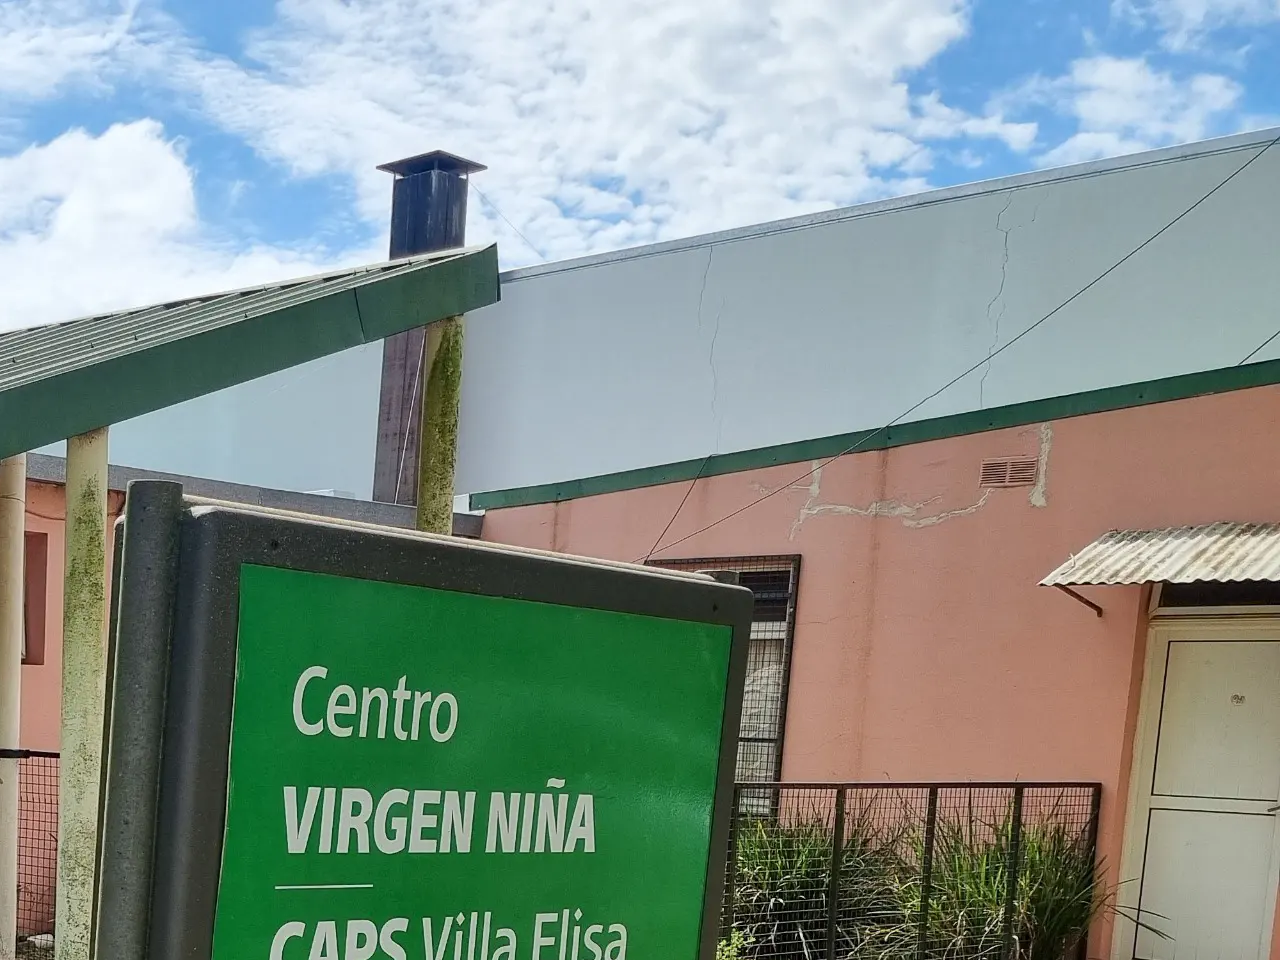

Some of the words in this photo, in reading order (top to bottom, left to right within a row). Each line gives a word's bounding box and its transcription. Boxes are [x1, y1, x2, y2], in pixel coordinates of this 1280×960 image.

[292, 665, 458, 743] Centro
[283, 786, 476, 854] VIRGEN
[486, 777, 596, 853] NIÑA
